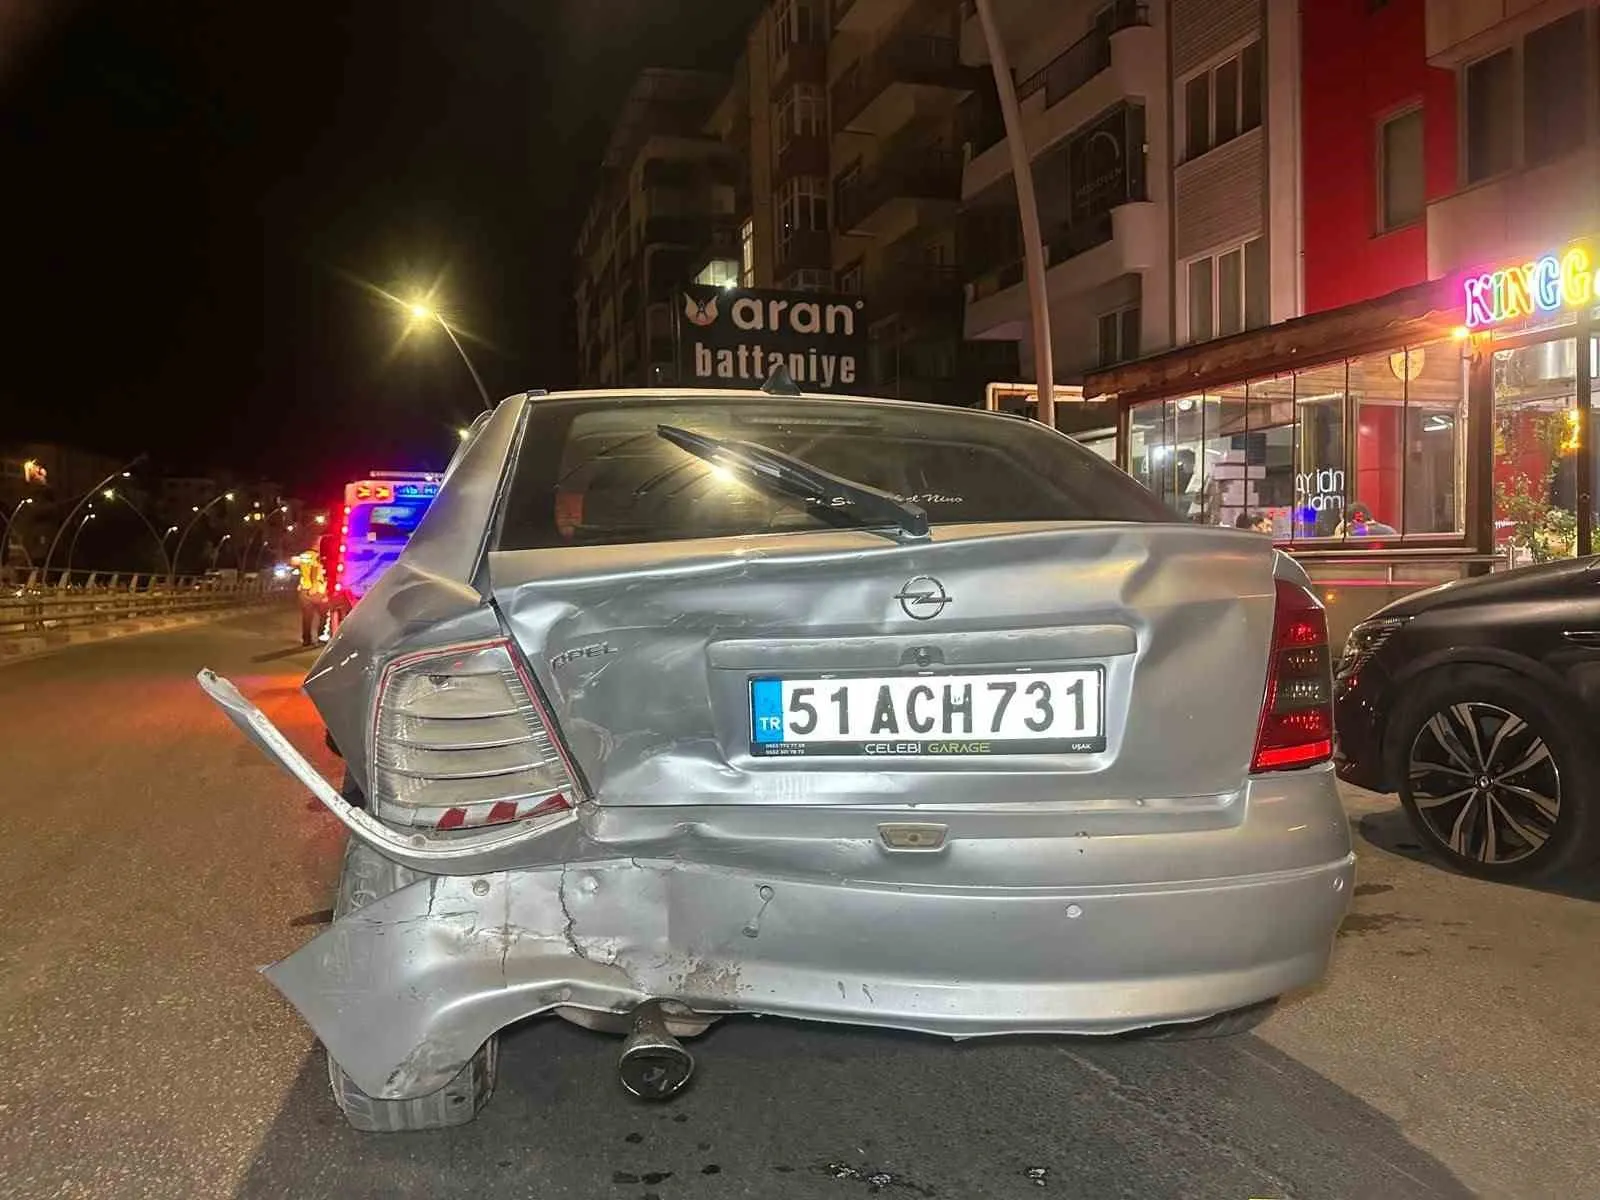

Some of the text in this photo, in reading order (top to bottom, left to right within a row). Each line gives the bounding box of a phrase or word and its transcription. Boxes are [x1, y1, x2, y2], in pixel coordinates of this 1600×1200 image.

[1464, 247, 1600, 327] KINGG
[731, 298, 854, 335] aran
[759, 716, 781, 731] TR
[789, 679, 1085, 735] 51 ACH 731
[927, 742, 991, 753] GARAGE
